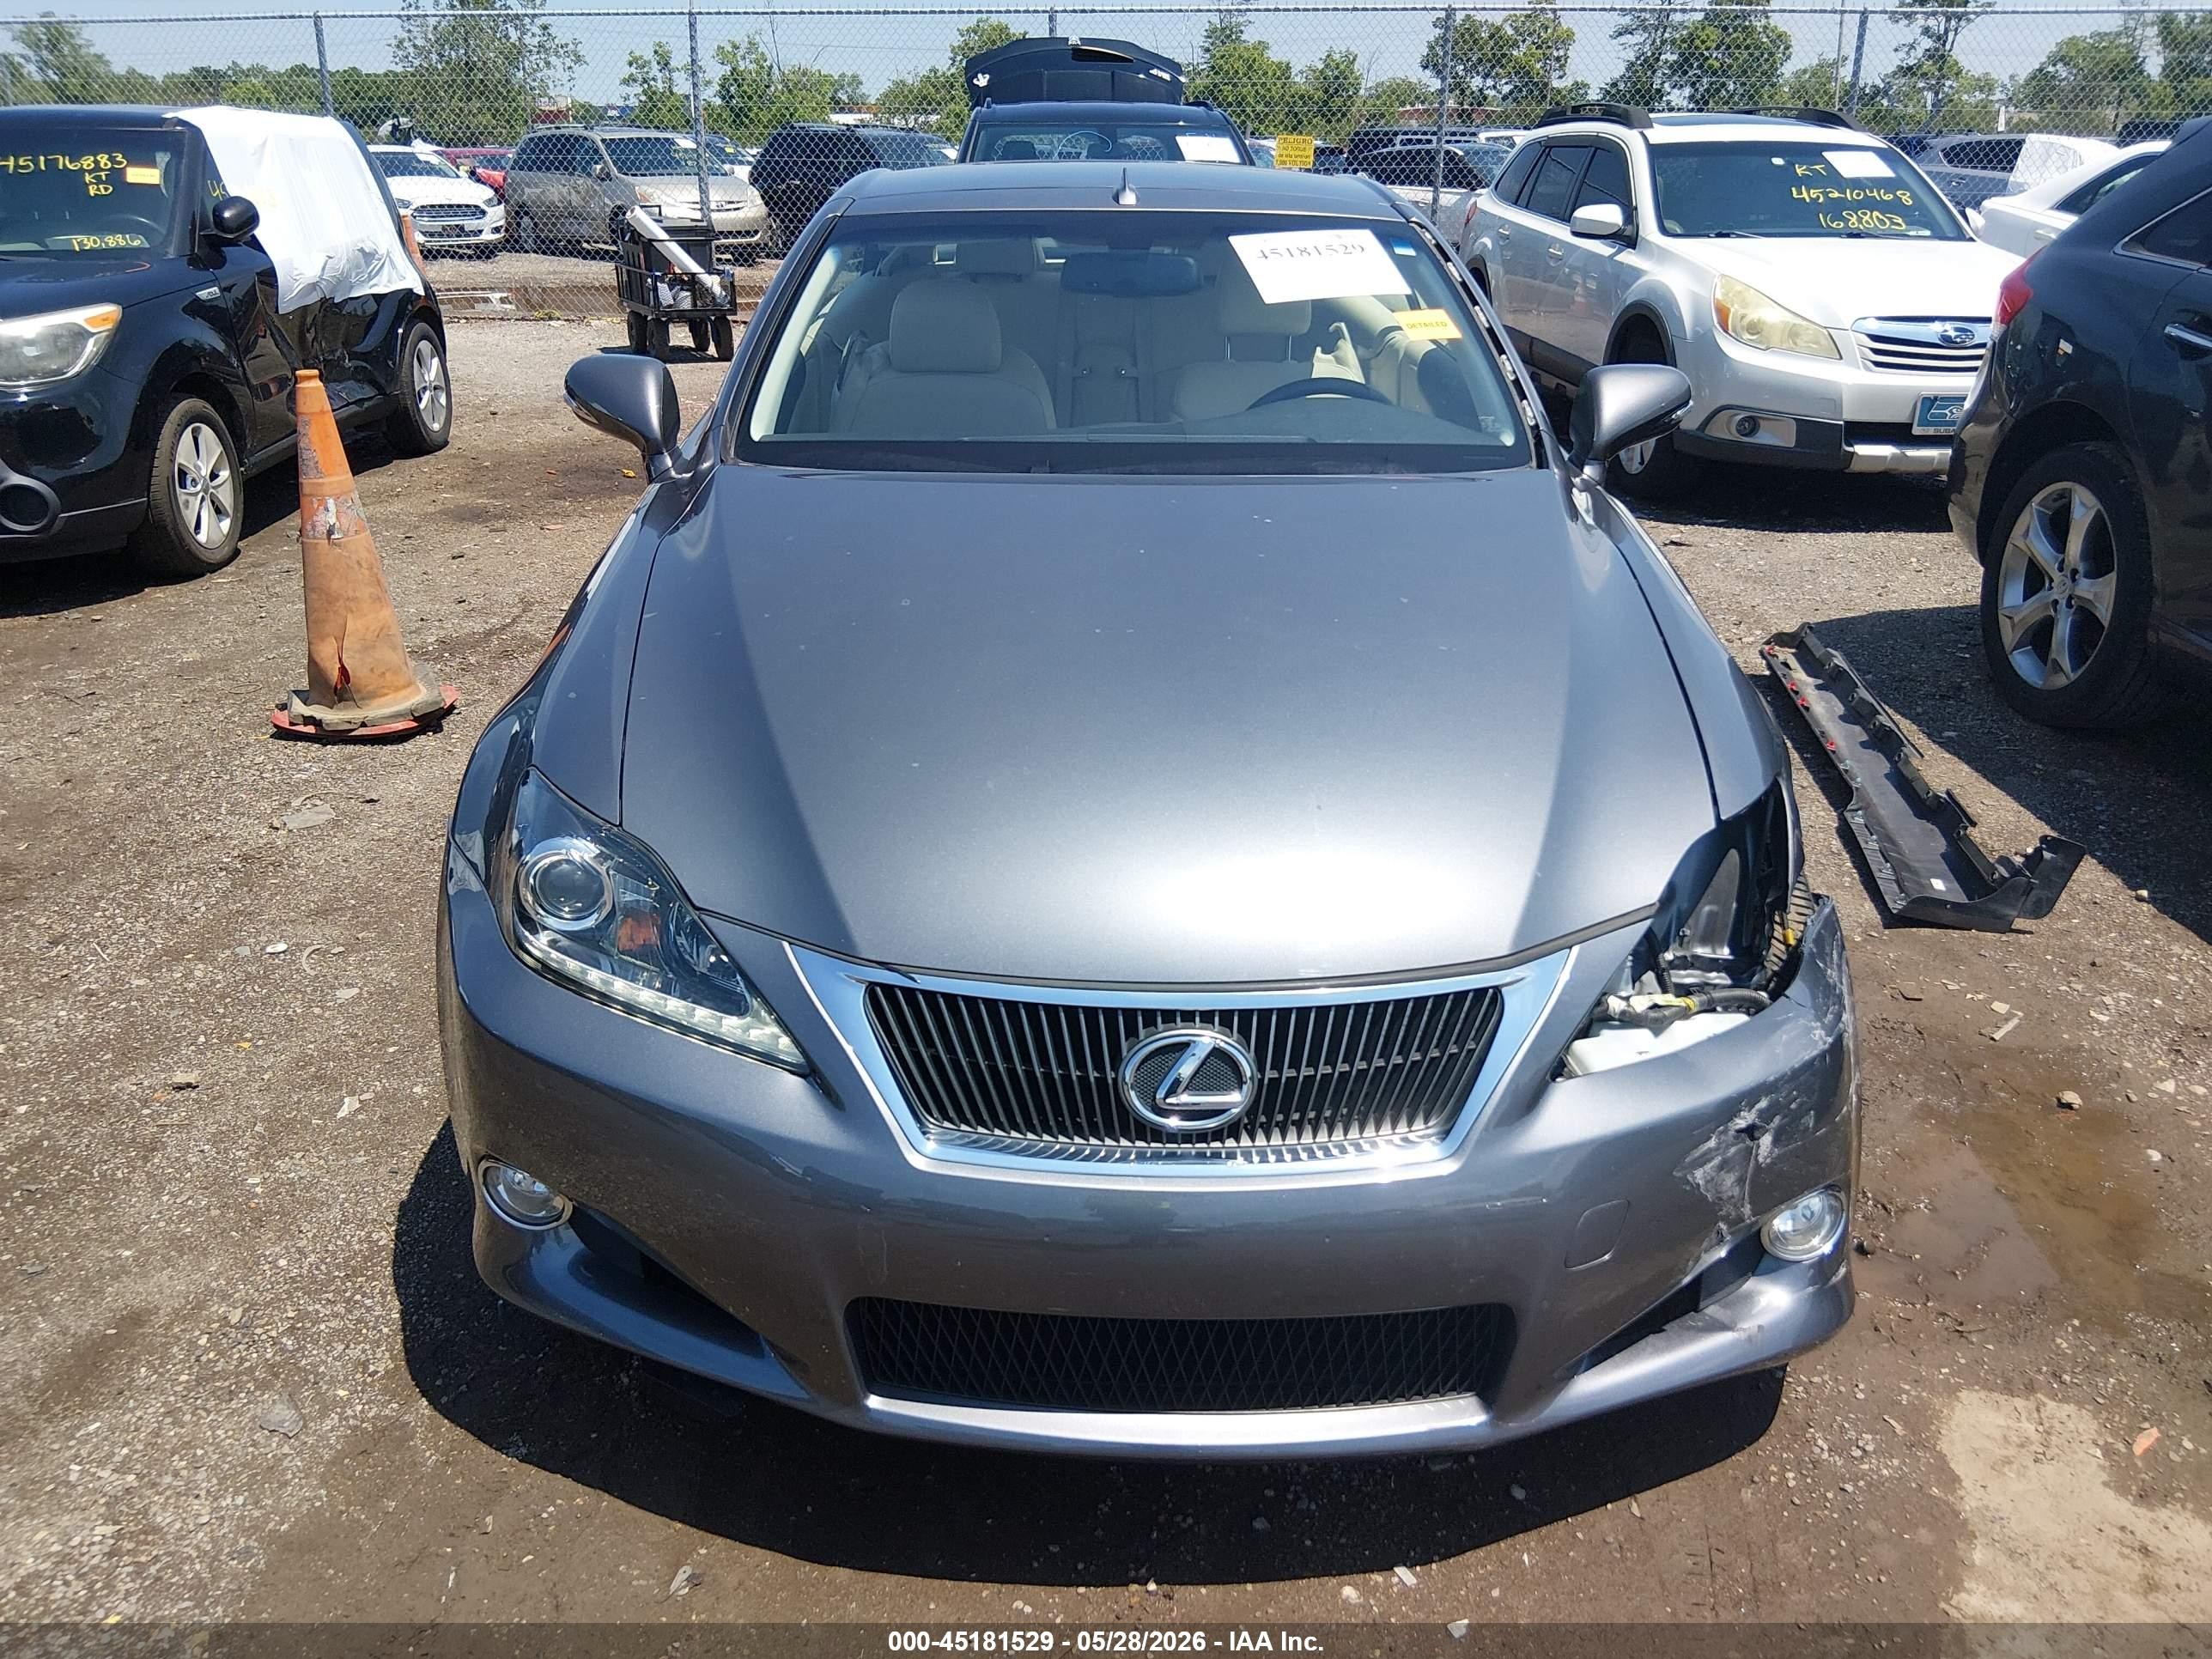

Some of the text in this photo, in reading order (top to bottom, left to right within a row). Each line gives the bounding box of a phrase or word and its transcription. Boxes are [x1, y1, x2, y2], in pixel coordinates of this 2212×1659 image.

[1795, 164, 1827, 177] KT
[85, 172, 111, 184] KT
[88, 185, 113, 197] RD
[1791, 185, 1913, 205] 45210468
[1819, 210, 1906, 230] 168,803
[1256, 244, 1367, 259] 45181529
[1407, 321, 1448, 330] DETAILED
